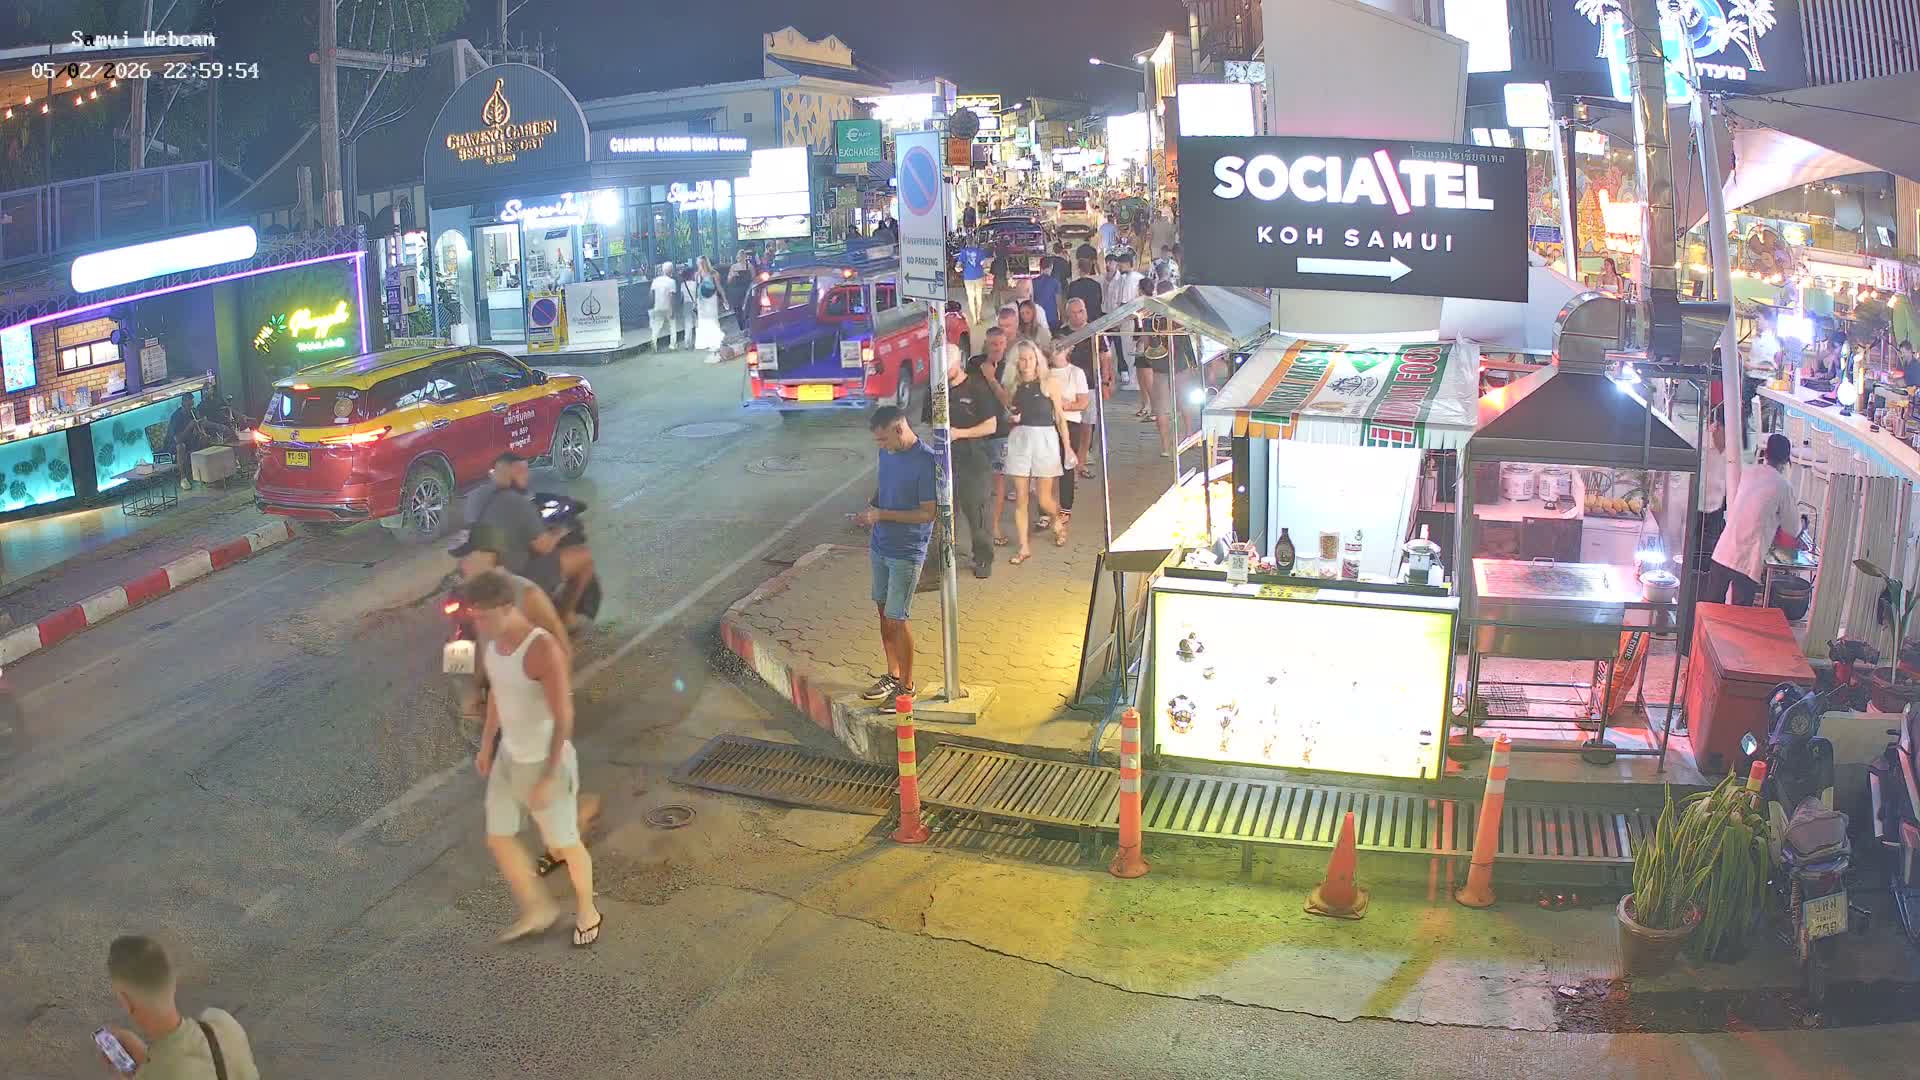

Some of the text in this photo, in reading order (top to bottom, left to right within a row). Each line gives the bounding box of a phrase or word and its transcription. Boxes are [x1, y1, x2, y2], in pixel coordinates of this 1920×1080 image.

[839, 147, 880, 158] EXCHANGE
[1256, 225, 1453, 252] KOH SAMUI
[906, 255, 939, 266] NO PARKING
